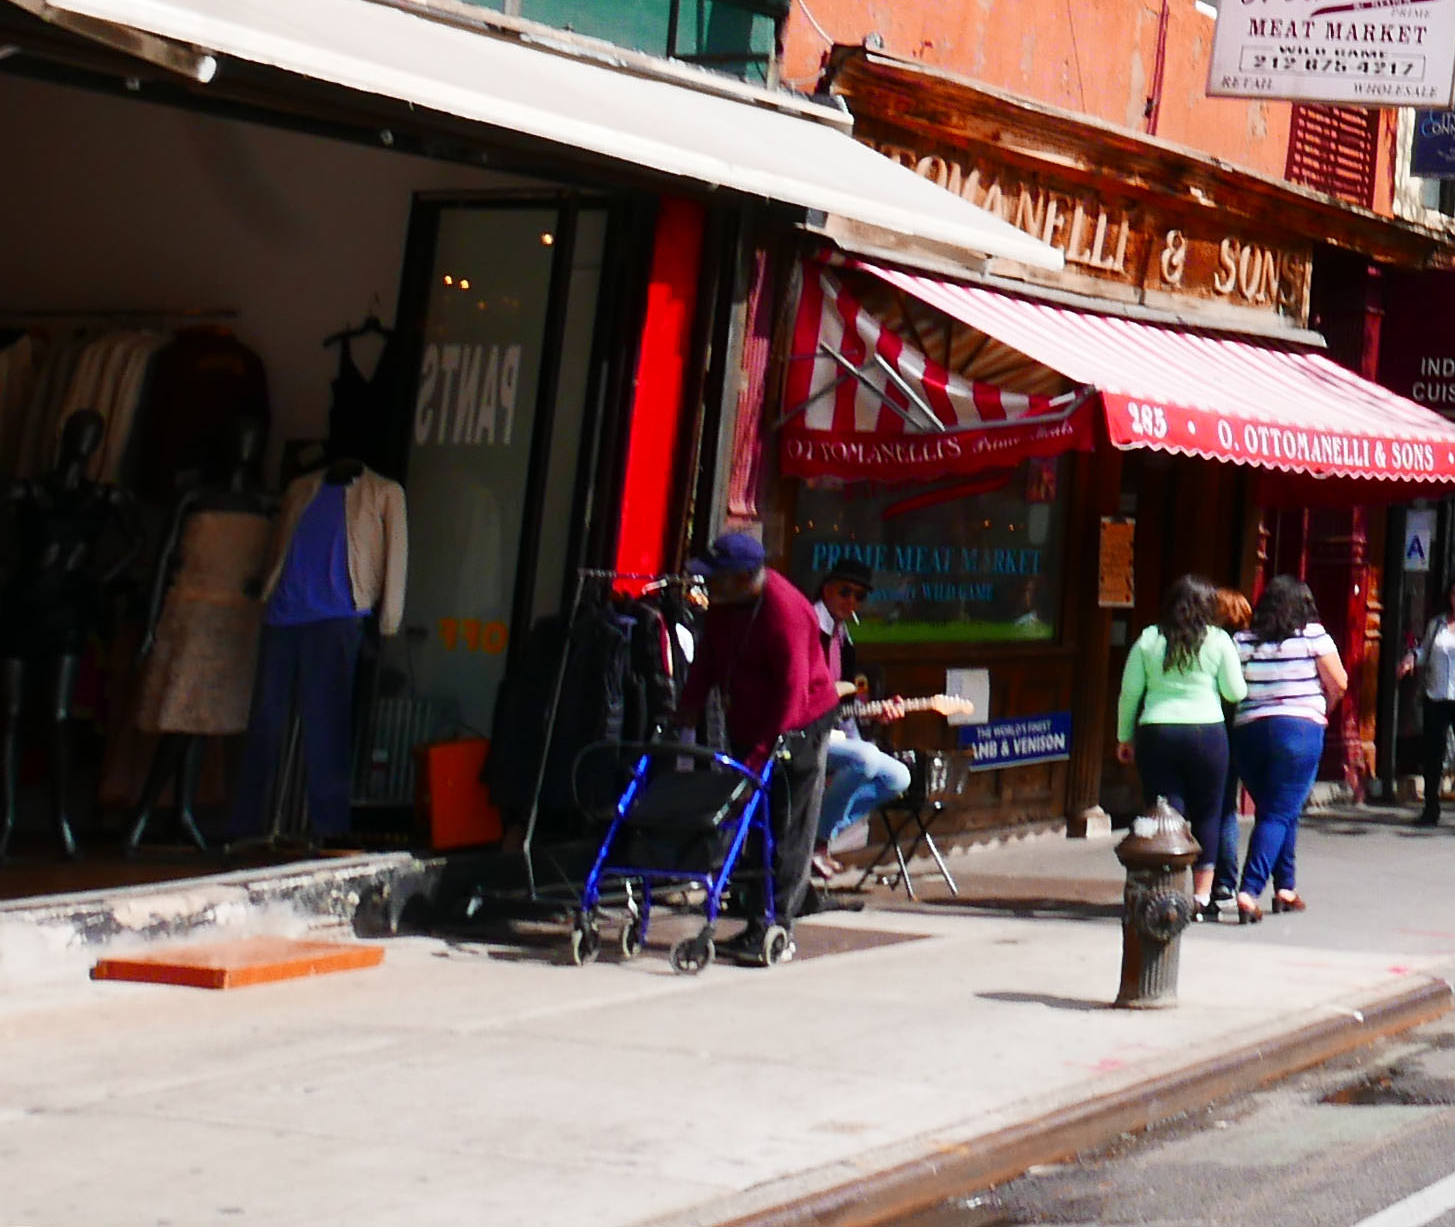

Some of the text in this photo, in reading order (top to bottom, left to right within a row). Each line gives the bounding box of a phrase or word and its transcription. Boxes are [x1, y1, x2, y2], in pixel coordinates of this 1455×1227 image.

[1248, 18, 1428, 45] MEAT MARKET
[1221, 75, 1438, 98] RETAIL WHOLESALE
[1161, 229, 1187, 289] &
[787, 437, 962, 464] OTTOMANELLI'S
[1217, 420, 1240, 452] O.
[1244, 424, 1371, 467] OTTOMANELLI
[1374, 441, 1386, 469] &
[1391, 445, 1434, 471] SONS
[896, 544, 953, 572] MEAT
[1406, 534, 1425, 560] A
[971, 741, 997, 760] AMB
[1013, 732, 1066, 755] VENISON
